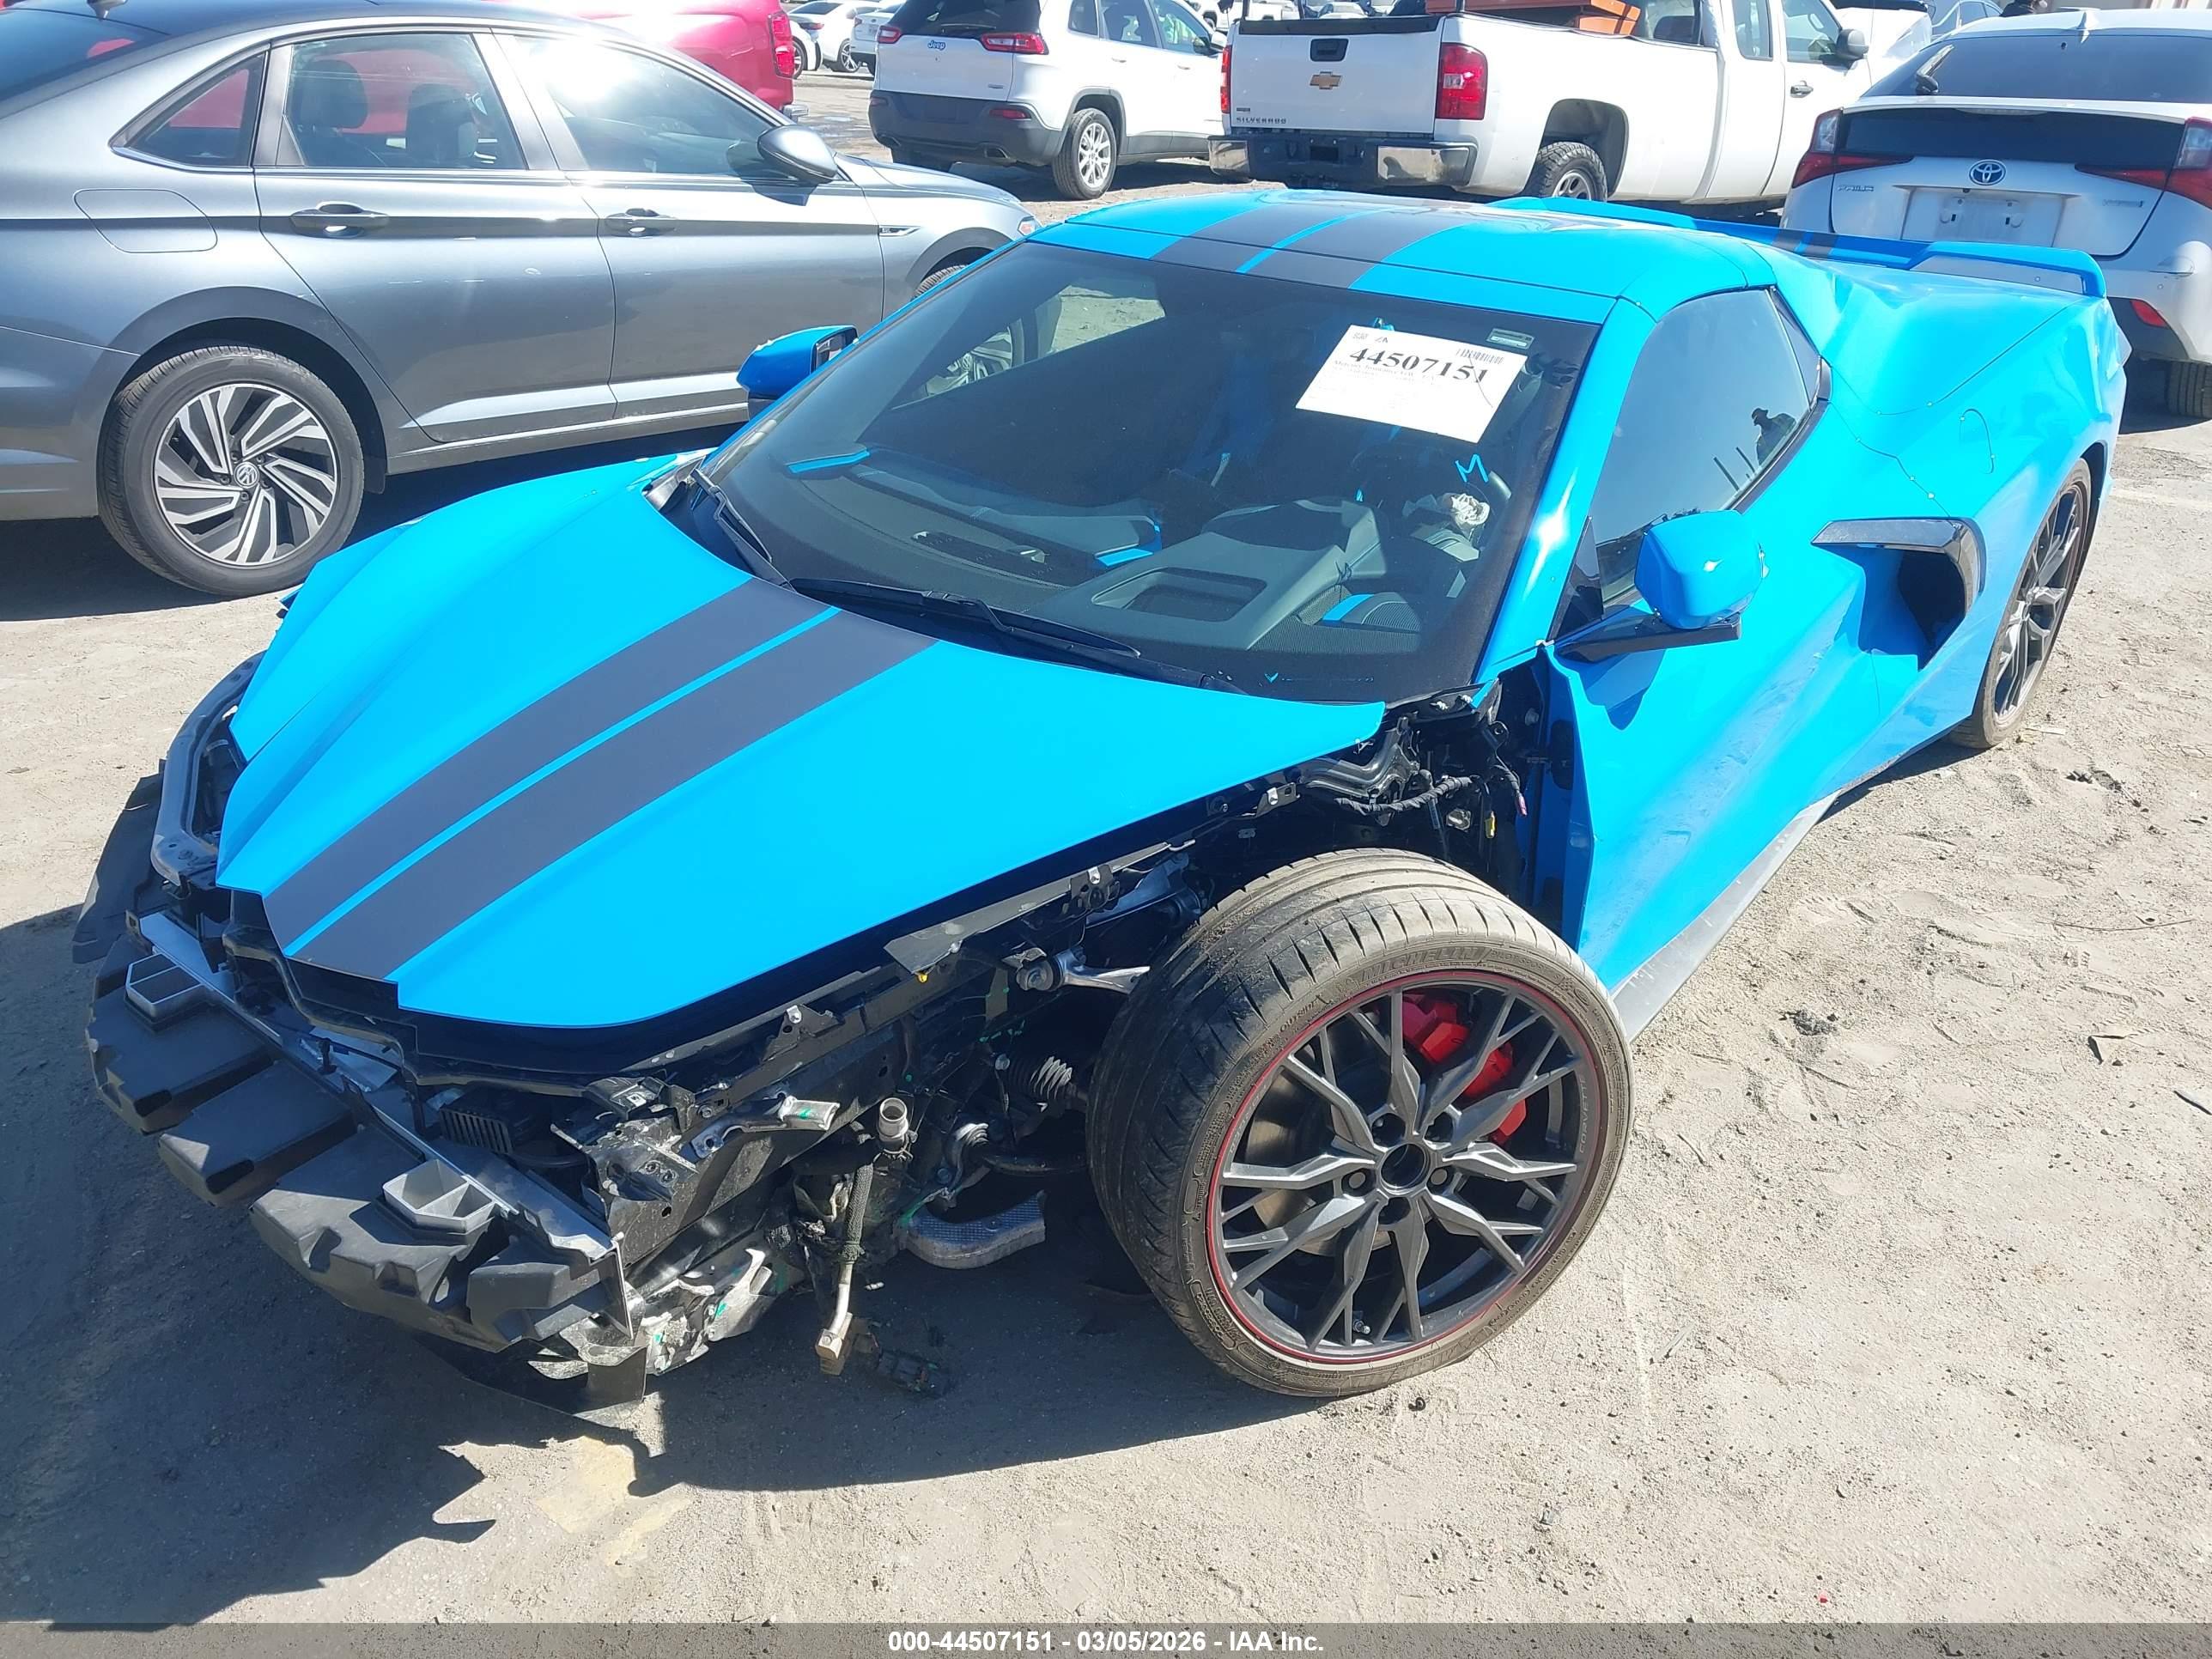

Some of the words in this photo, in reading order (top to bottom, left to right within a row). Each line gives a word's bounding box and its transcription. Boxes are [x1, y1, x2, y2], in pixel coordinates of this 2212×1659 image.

[927, 40, 946, 51] Jeep
[1349, 347, 1489, 383] 44507151
[1455, 453, 1489, 483] M
[1360, 945, 1482, 981] MICHELIN
[1579, 1074, 1589, 1153] CORVETTE
